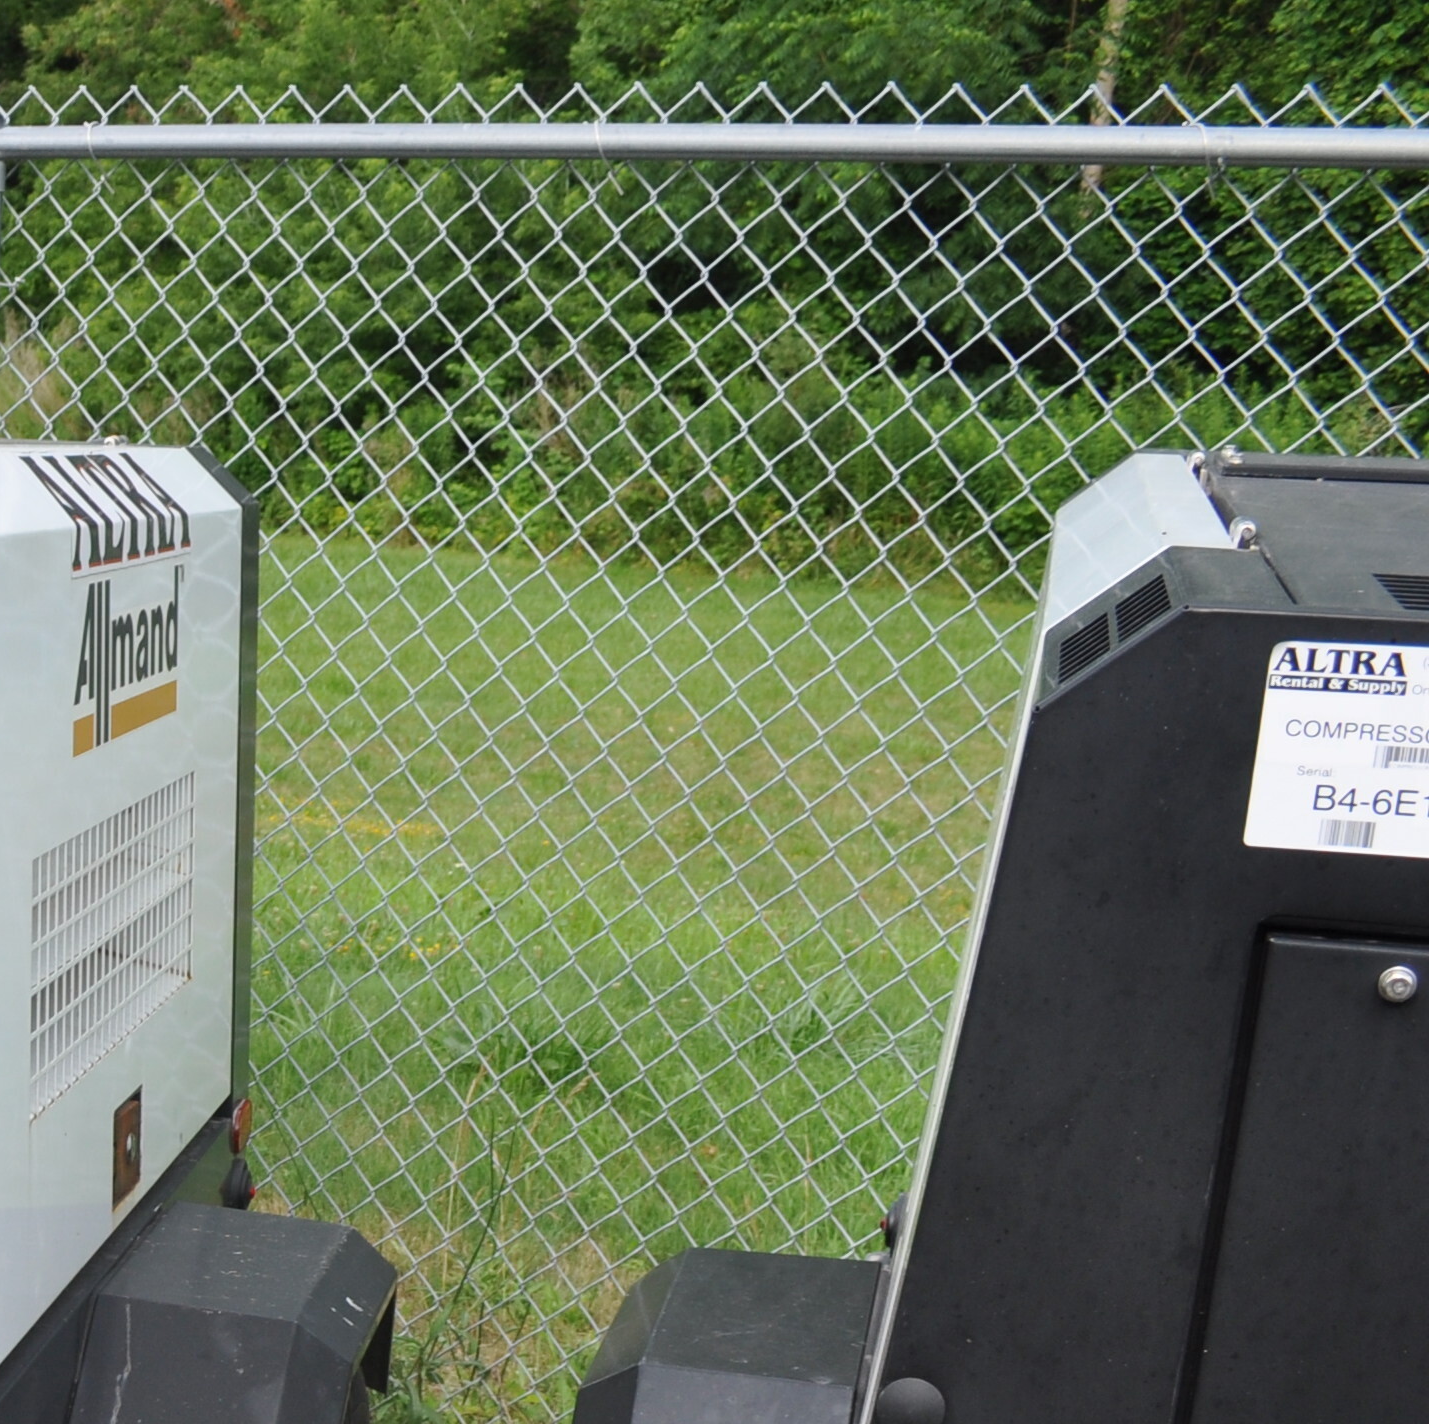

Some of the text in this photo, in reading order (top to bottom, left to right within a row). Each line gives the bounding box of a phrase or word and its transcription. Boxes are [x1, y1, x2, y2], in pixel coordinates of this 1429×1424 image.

[19, 453, 191, 571] ALTRA
[73, 564, 179, 748] Allmand
[1273, 647, 1406, 677] ALTRA
[1270, 675, 1324, 690] Rental
[1328, 678, 1343, 690] &
[1348, 679, 1406, 696] Supply
[1285, 719, 1429, 744] COMPRESS
